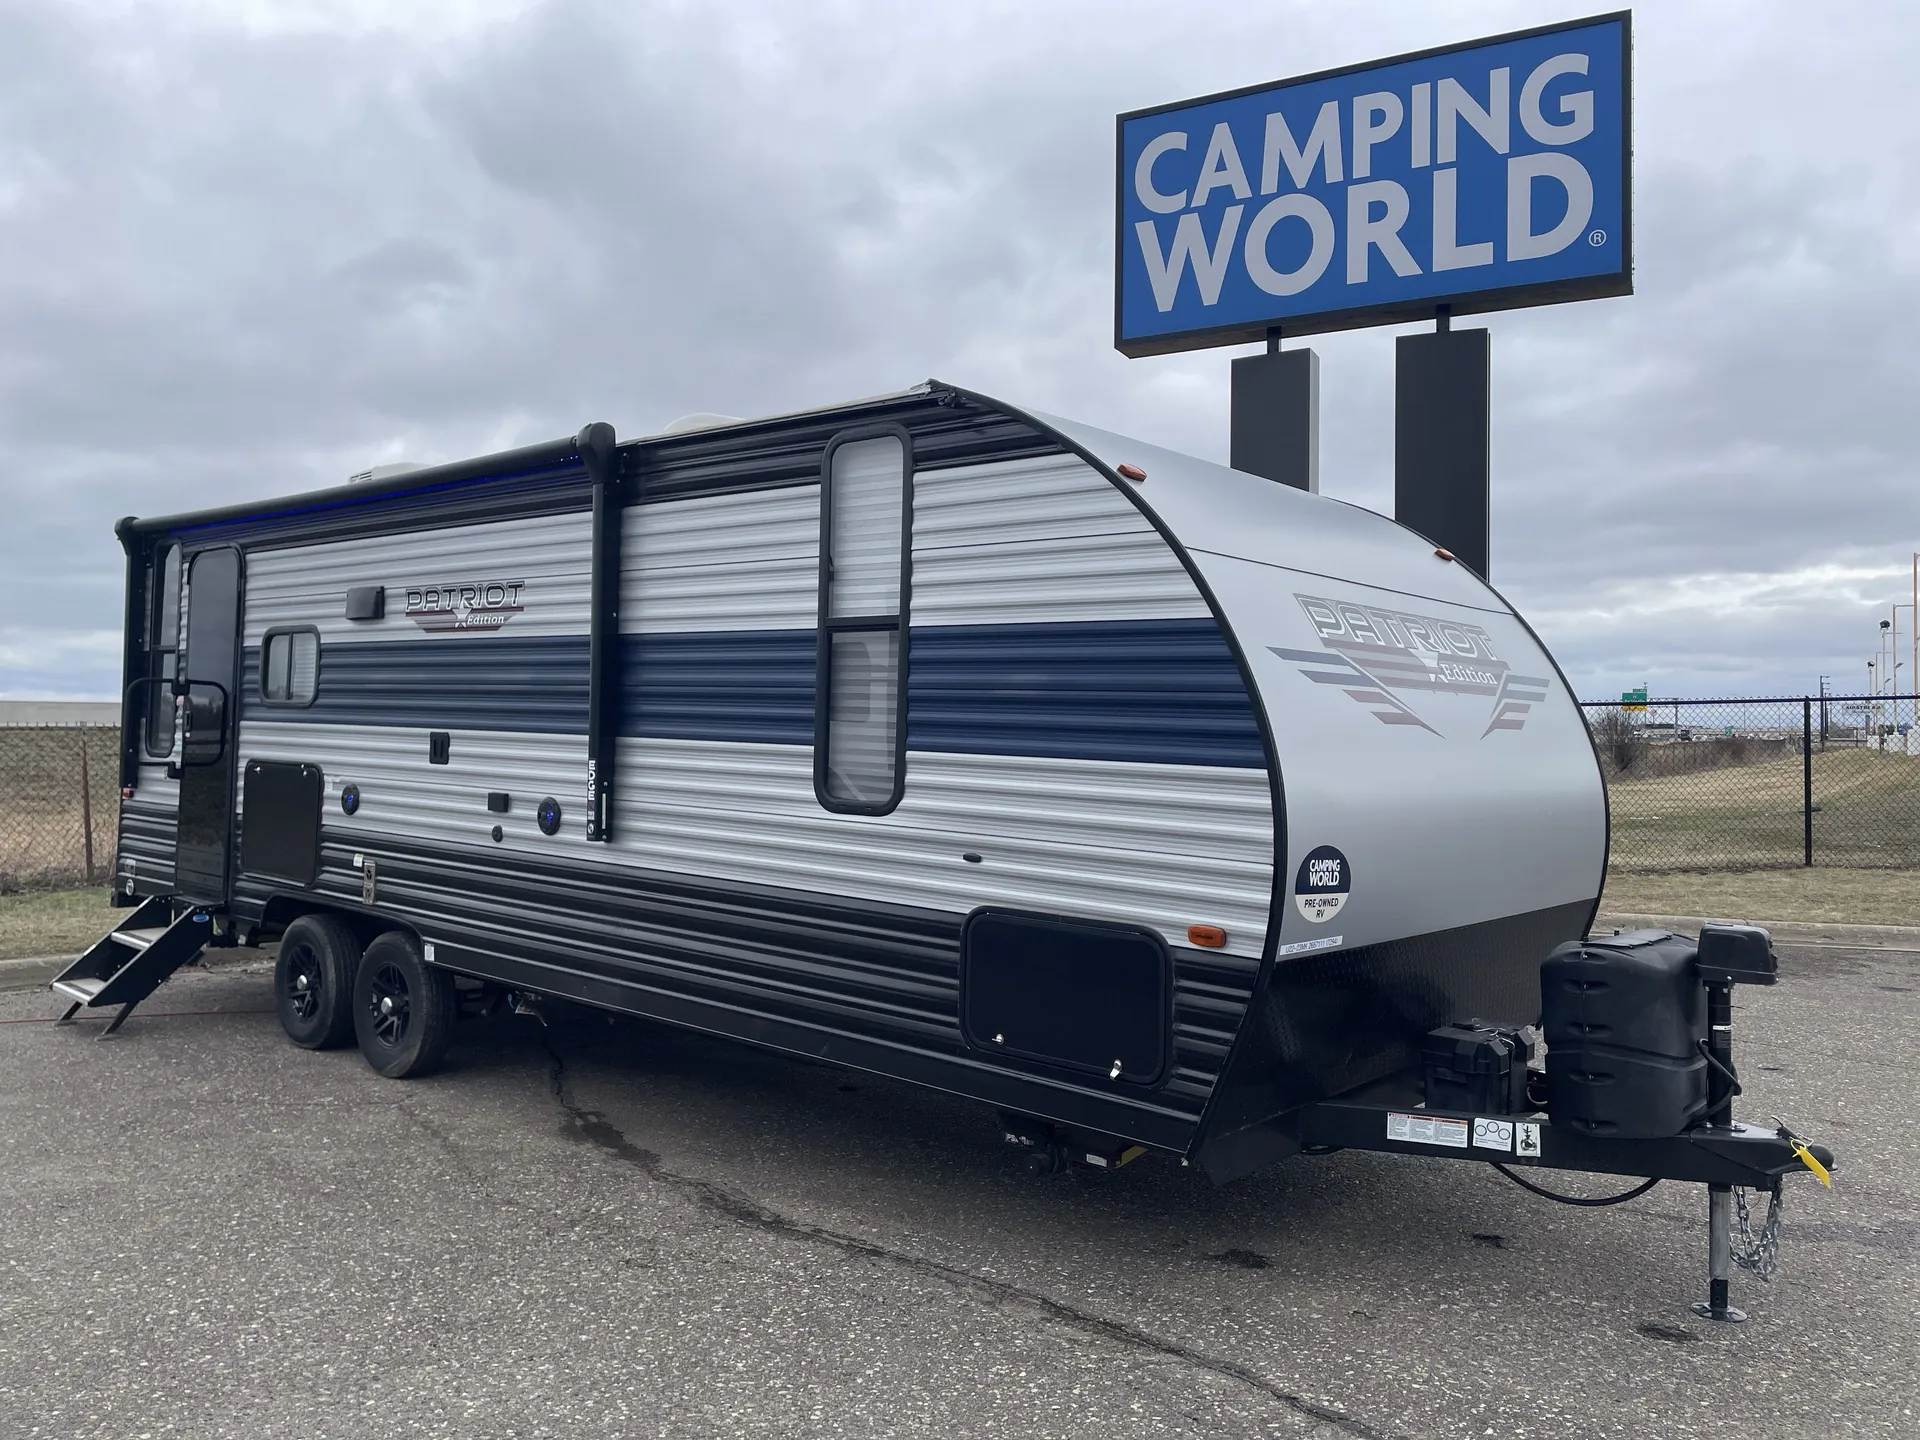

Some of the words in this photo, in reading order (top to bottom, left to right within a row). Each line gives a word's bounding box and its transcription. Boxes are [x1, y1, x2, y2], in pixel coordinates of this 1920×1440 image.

[1135, 53, 1594, 214] CAMPING
[1135, 152, 1594, 312] WORLD
[406, 581, 525, 612] PATRIOT
[466, 614, 504, 626] Edition
[1297, 597, 1499, 661] PATRIOT
[1442, 664, 1498, 685] Edition
[588, 760, 596, 800] EDGE
[1309, 859, 1341, 872] CAMPING
[1309, 872, 1340, 886] WORLD
[1304, 898, 1339, 908] PRE-OWNED
[1316, 909, 1325, 918] RV
